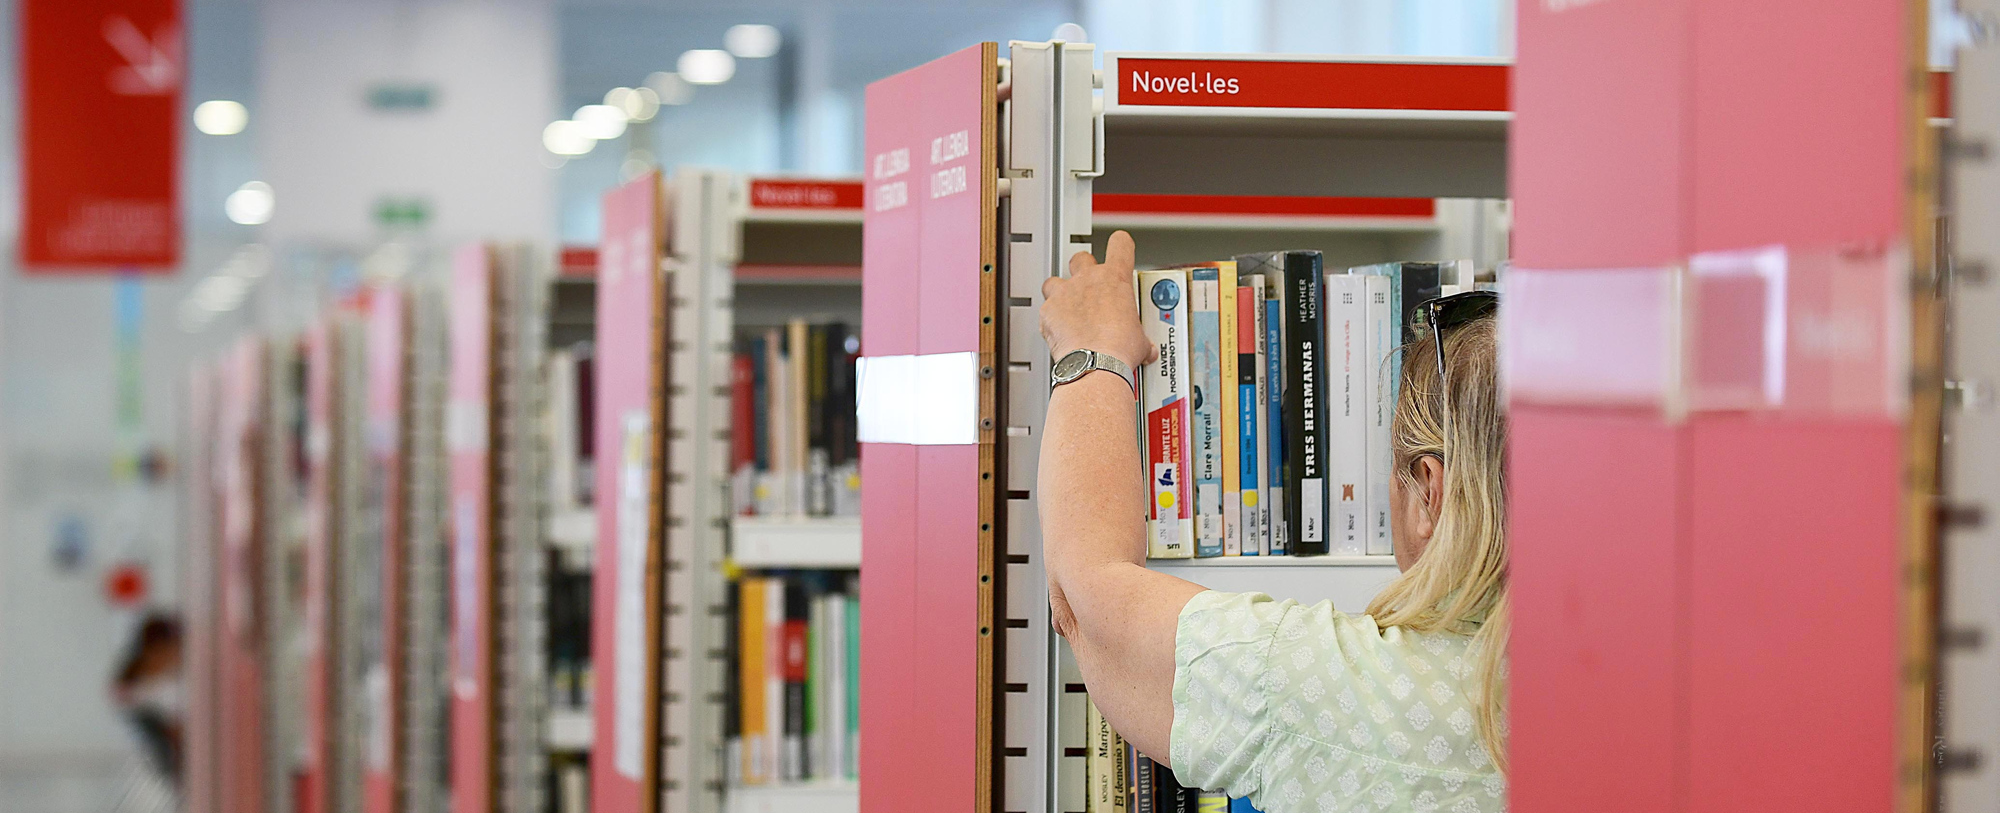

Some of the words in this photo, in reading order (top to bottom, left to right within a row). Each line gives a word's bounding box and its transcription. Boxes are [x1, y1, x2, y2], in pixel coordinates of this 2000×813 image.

[1131, 70, 1241, 96] Novel·les
[1299, 278, 1307, 323] HEATHER
[1308, 282, 1317, 319] MORRIS
[1160, 343, 1168, 377] DAVIDE
[1168, 326, 1177, 394] MOROSINOTTO
[1302, 341, 1315, 431] HERMANAS
[1161, 417, 1171, 434] LUZ
[1203, 413, 1212, 450] Morrall
[1204, 453, 1212, 480] Clare
[1304, 435, 1316, 477] TRES
[1113, 748, 1125, 793] demonio
[1140, 765, 1151, 795] MOSLEY
[1114, 796, 1125, 807] El
[1140, 798, 1151, 813] TER
